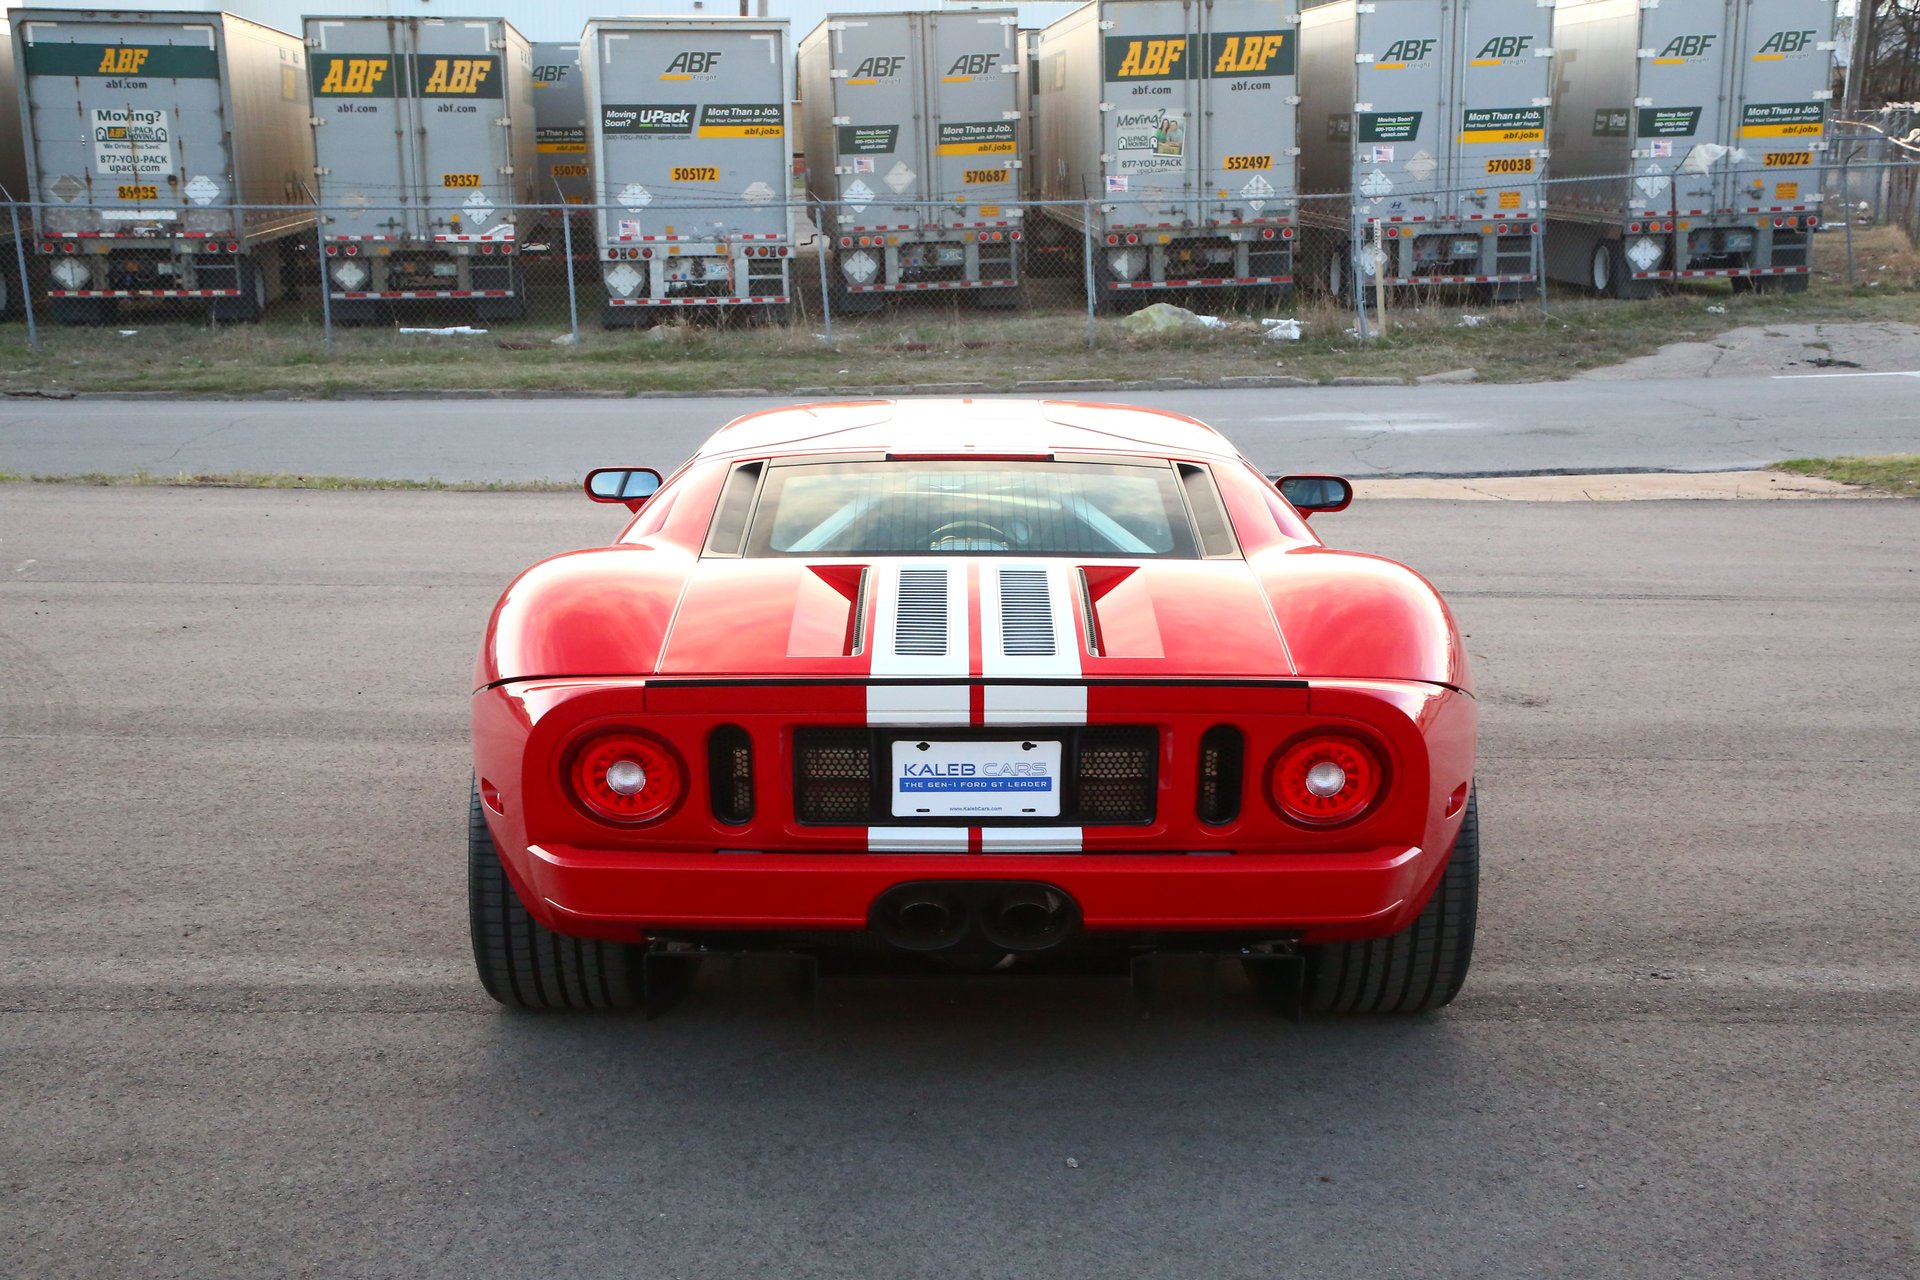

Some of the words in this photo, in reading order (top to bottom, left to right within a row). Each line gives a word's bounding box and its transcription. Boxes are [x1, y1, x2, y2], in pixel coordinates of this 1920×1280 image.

[1476, 36, 1534, 58] ABF
[1659, 35, 1717, 58] ABF
[1758, 30, 1816, 53] ABF
[1215, 36, 1283, 72] ABF
[1380, 39, 1437, 62] ABF
[98, 48, 149, 73] ABF
[665, 52, 722, 72] ABF
[947, 54, 1000, 75] ABF
[1118, 40, 1186, 76] ABF
[532, 65, 570, 82] ABF
[852, 56, 906, 78] ABF
[320, 59, 388, 93] ABF
[425, 59, 492, 94] ABF
[105, 79, 148, 89] abf.com
[1132, 86, 1172, 94] abf.com
[1231, 82, 1271, 91] abf.com
[337, 104, 378, 113] abf.com
[437, 104, 477, 113] abf.com
[606, 111, 637, 119] Moving
[1522, 111, 1542, 119] Job.
[1802, 106, 1820, 114] Job.
[97, 110, 162, 124] Moving?
[640, 110, 690, 123] U-Pack
[1116, 108, 1166, 128] Moving?
[1782, 126, 1818, 134] abf.jobs
[978, 144, 1012, 152] abf.jobs
[100, 155, 168, 164] 877-YOU-PACK
[1122, 159, 1182, 168] 877-YOU-PACK
[1228, 156, 1270, 170] 552497
[1487, 160, 1532, 172] 570038
[1766, 153, 1809, 166] 570272
[109, 164, 160, 174] upack.com
[554, 166, 588, 176] 550705
[674, 168, 715, 180] 505172
[444, 175, 480, 188] 89357
[966, 170, 1007, 183] 570687
[904, 764, 976, 776] KALEB
[982, 763, 1048, 776] CARS
